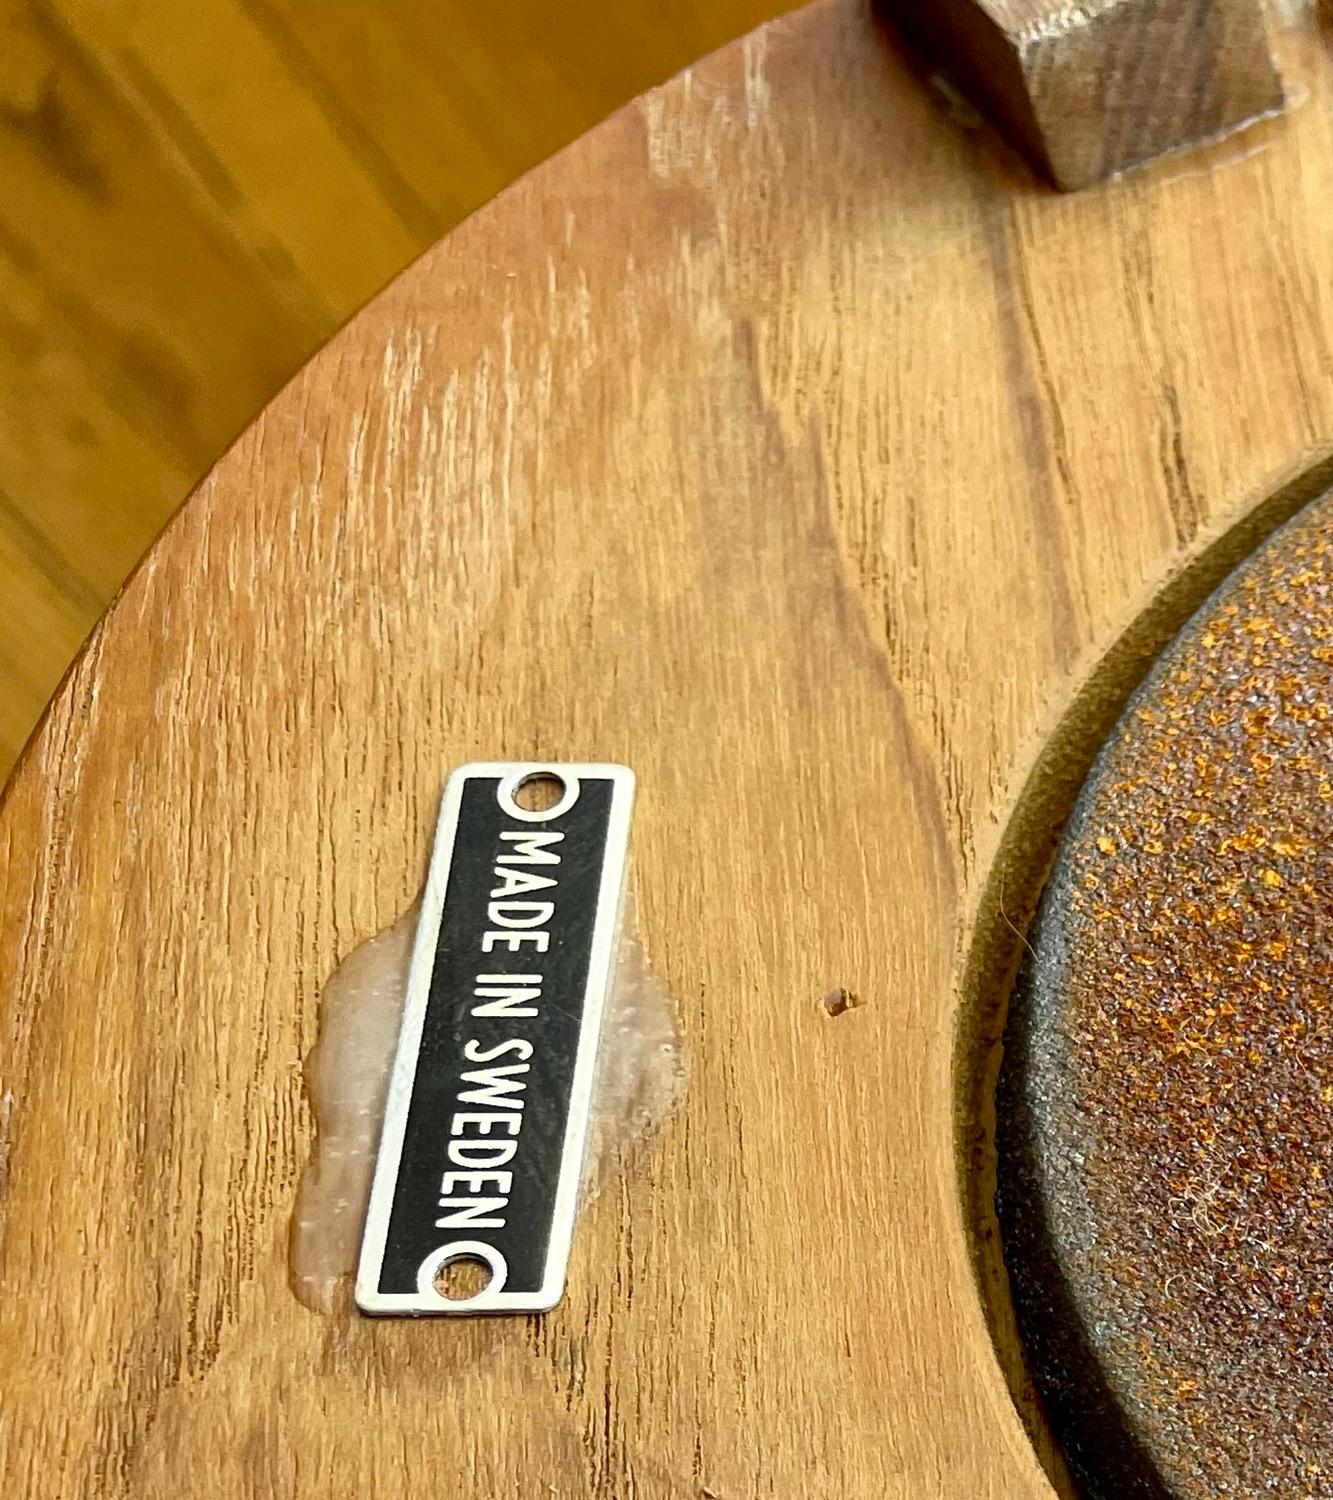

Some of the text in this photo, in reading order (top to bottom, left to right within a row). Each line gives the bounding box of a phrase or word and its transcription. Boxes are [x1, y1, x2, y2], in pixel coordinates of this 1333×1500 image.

[435, 831, 565, 1229] MADE IN SWEDEN
